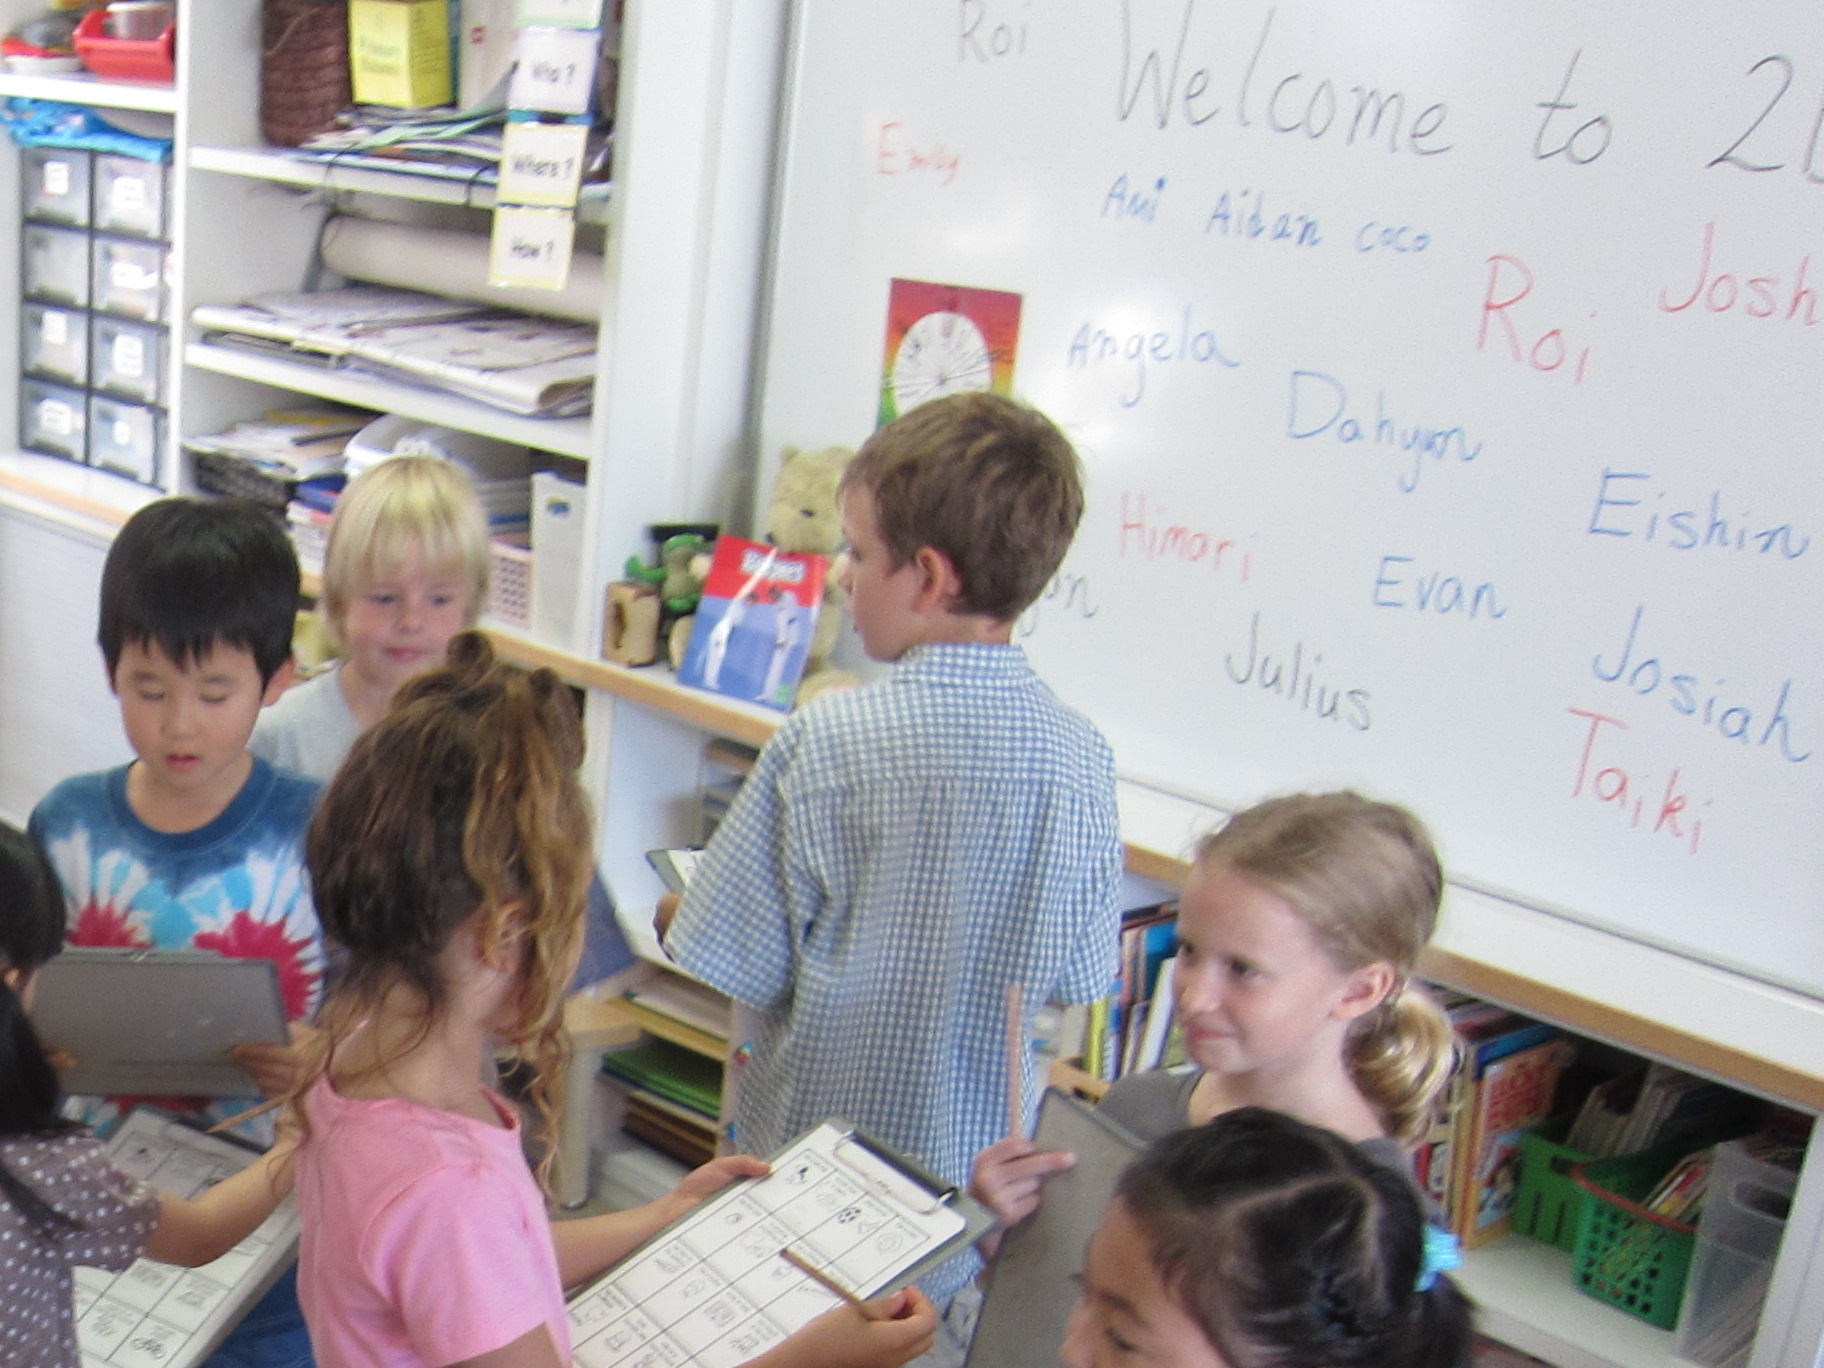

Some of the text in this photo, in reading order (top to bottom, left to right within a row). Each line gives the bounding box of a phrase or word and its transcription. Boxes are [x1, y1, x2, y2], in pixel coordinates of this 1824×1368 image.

[1118, 0, 1455, 156] Welcome
[1534, 47, 1614, 165] to
[1205, 188, 1323, 247] Aidan
[1657, 220, 1820, 327] Josh
[1065, 302, 1241, 408] Angela
[1475, 253, 1600, 385] Roi
[1587, 467, 1811, 560] Eishin
[1373, 555, 1508, 620] Evan
[1224, 610, 1373, 732] Julius
[1591, 604, 1813, 764] Josiah
[1566, 707, 1714, 856] Taiki
